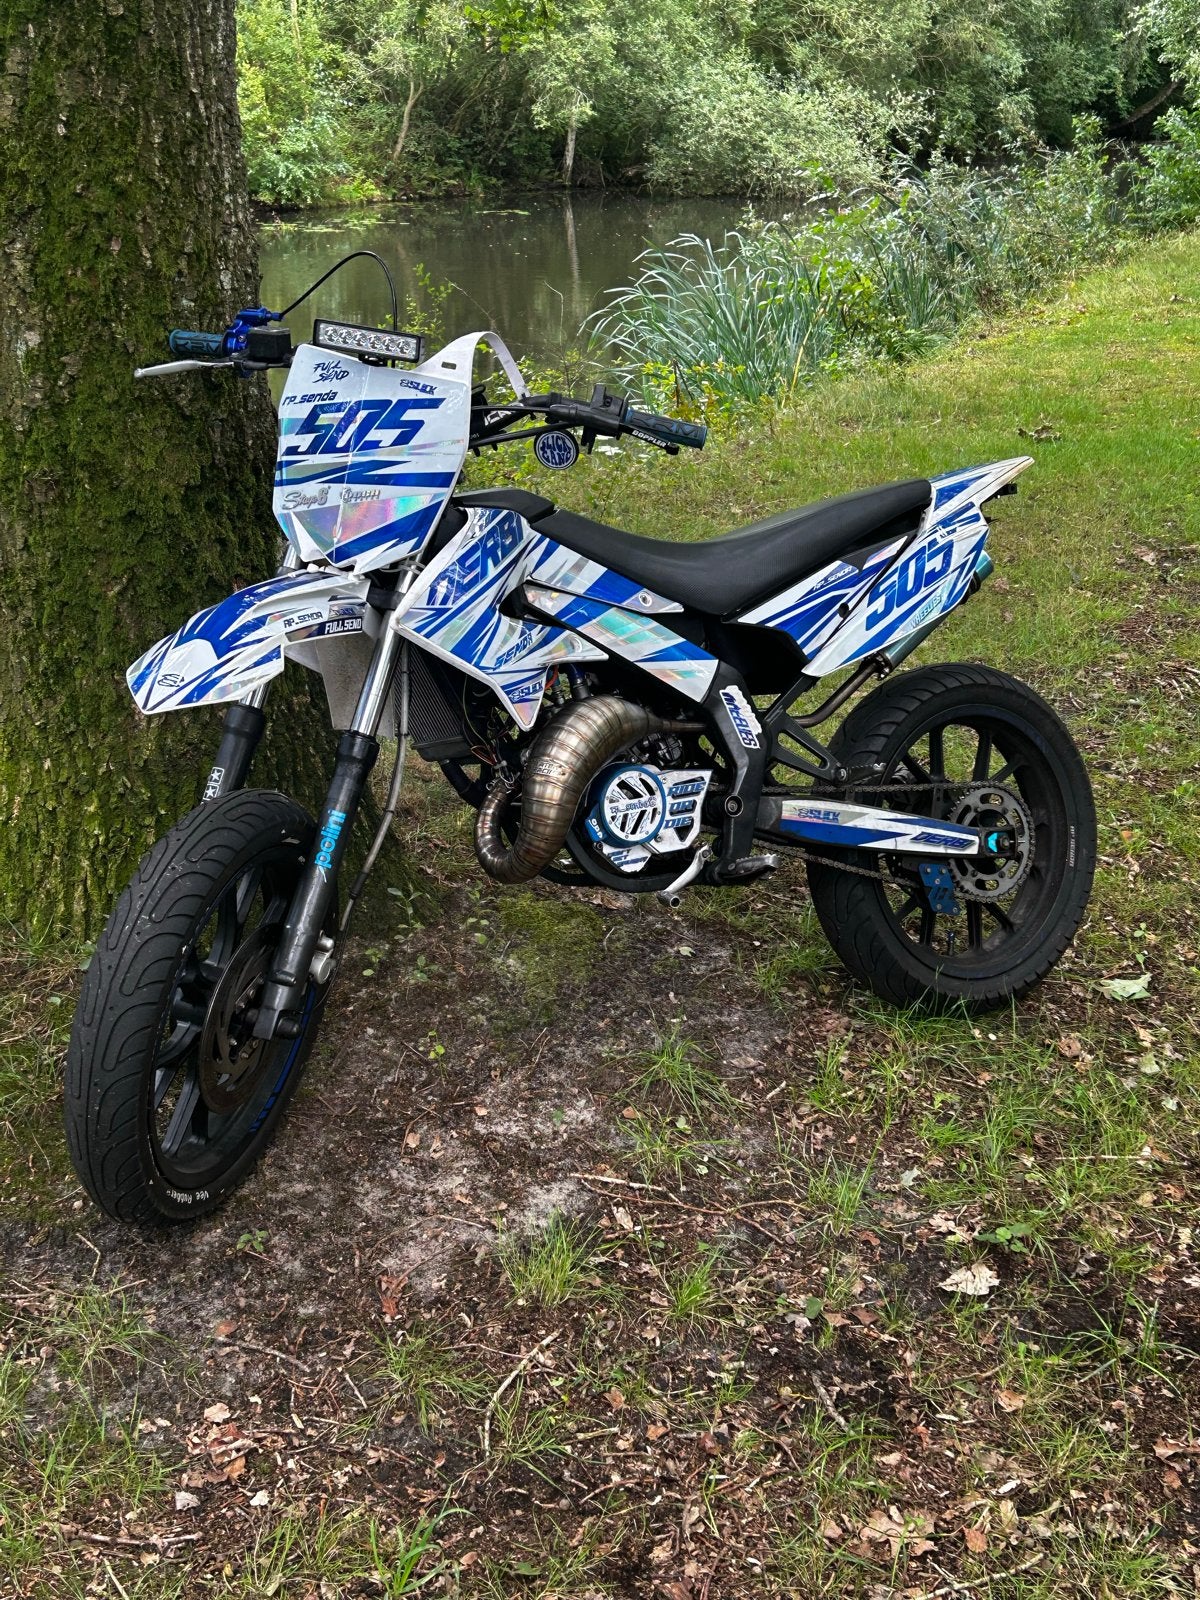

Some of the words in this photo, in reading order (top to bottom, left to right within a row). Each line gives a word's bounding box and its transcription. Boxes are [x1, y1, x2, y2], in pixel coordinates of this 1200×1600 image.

[282, 388, 339, 406] rp_senda
[281, 397, 447, 457] 505
[631, 429, 667, 448] DOPPLER
[865, 533, 955, 632] 505
[324, 620, 344, 635] FULL
[343, 618, 362, 631] SEND
[494, 632, 533, 670] SENDA
[667, 781, 707, 797] RIDE
[669, 800, 694, 814] OR
[665, 816, 692, 829] DIE
[315, 809, 346, 869] polini
[170, 1189, 193, 1204] Rubber
[195, 1190, 209, 1201] Vee
